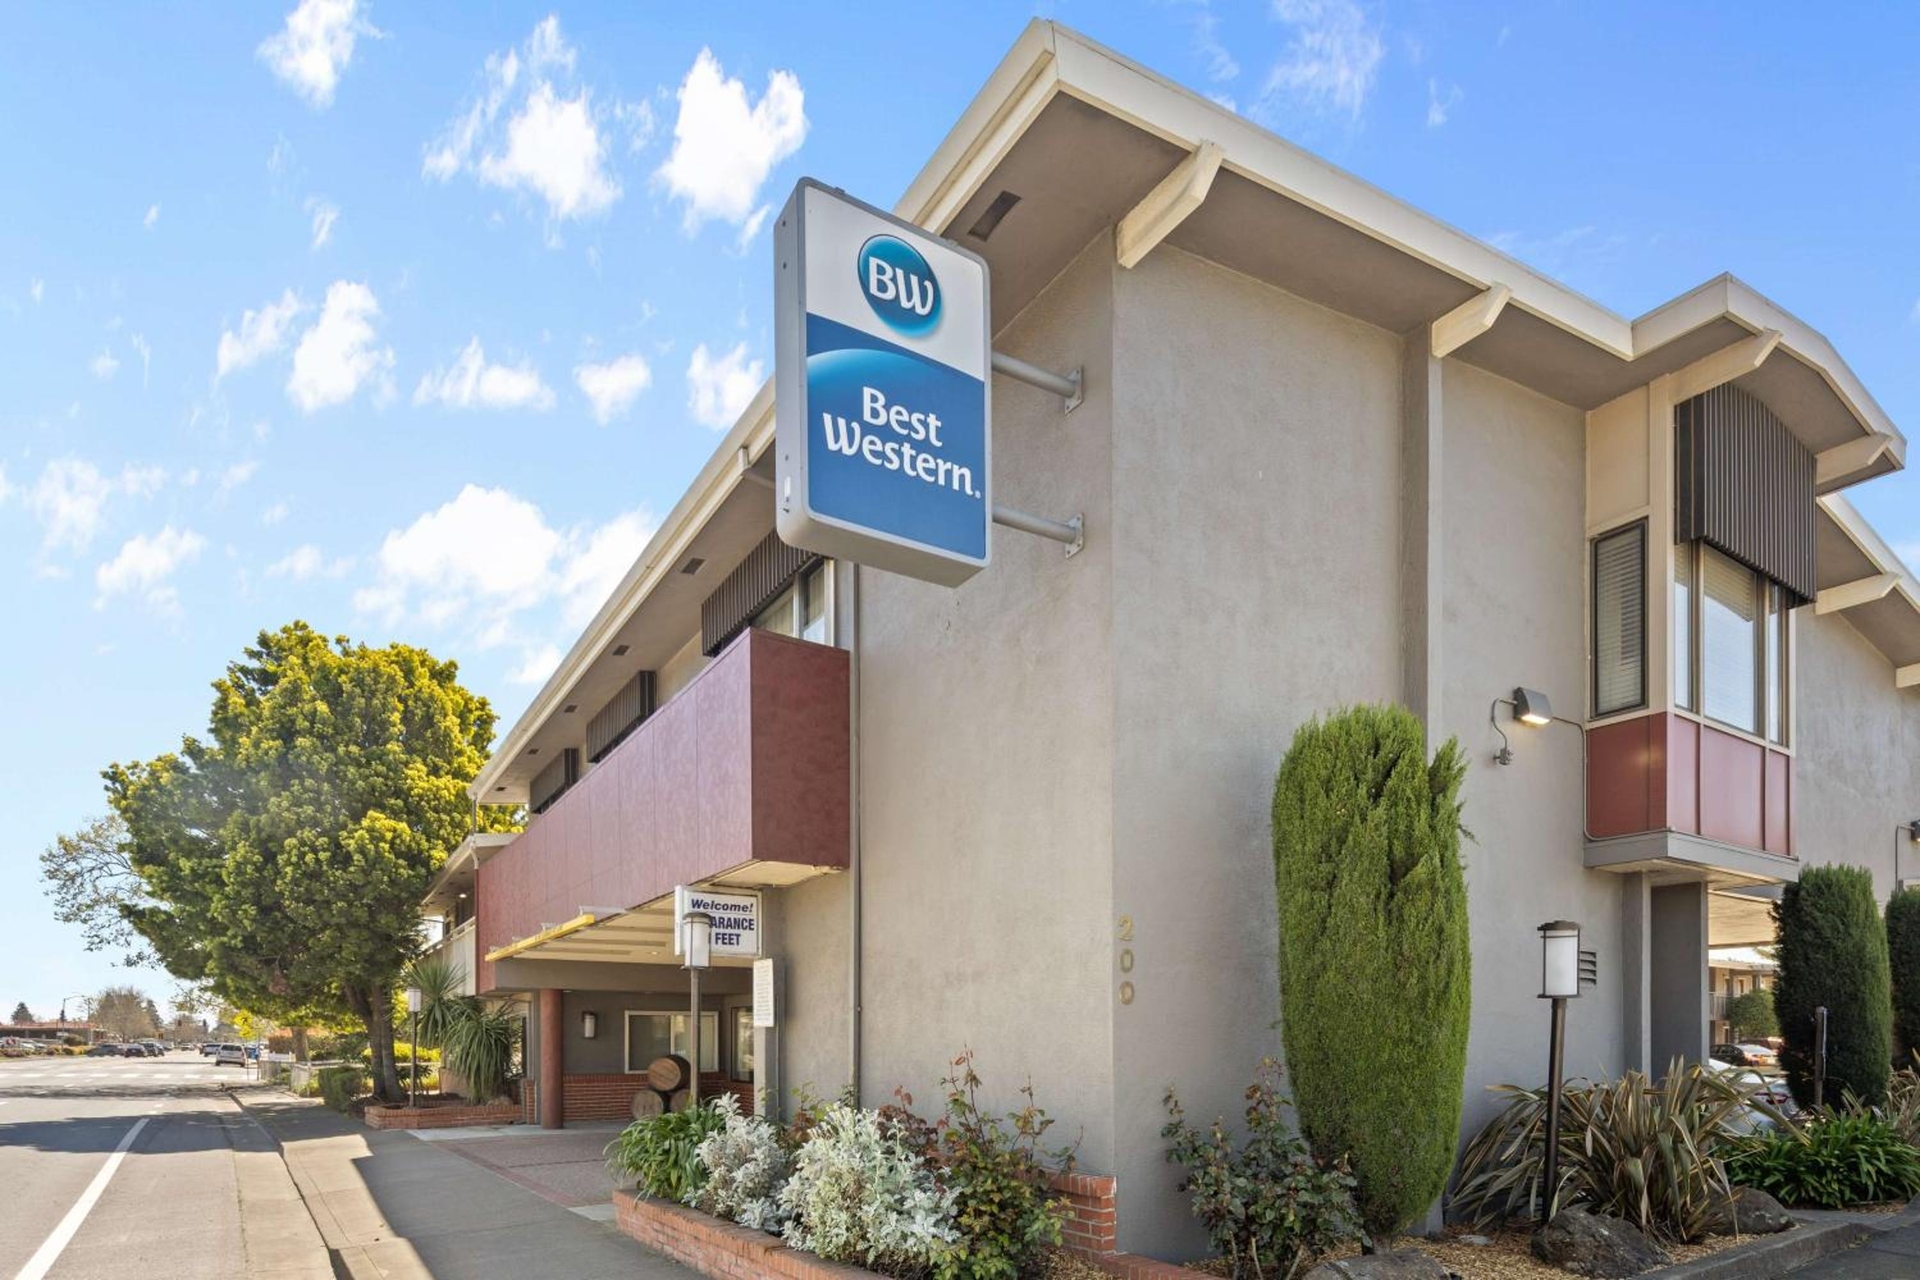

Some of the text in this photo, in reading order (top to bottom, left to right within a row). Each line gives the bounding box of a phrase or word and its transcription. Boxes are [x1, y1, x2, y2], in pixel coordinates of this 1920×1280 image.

[868, 256, 934, 316] BW
[863, 386, 943, 447] Best
[691, 899, 754, 912] Welcome!
[711, 916, 755, 931] ARANCE
[714, 932, 741, 946] FEET
[1118, 914, 1135, 1006] 200
